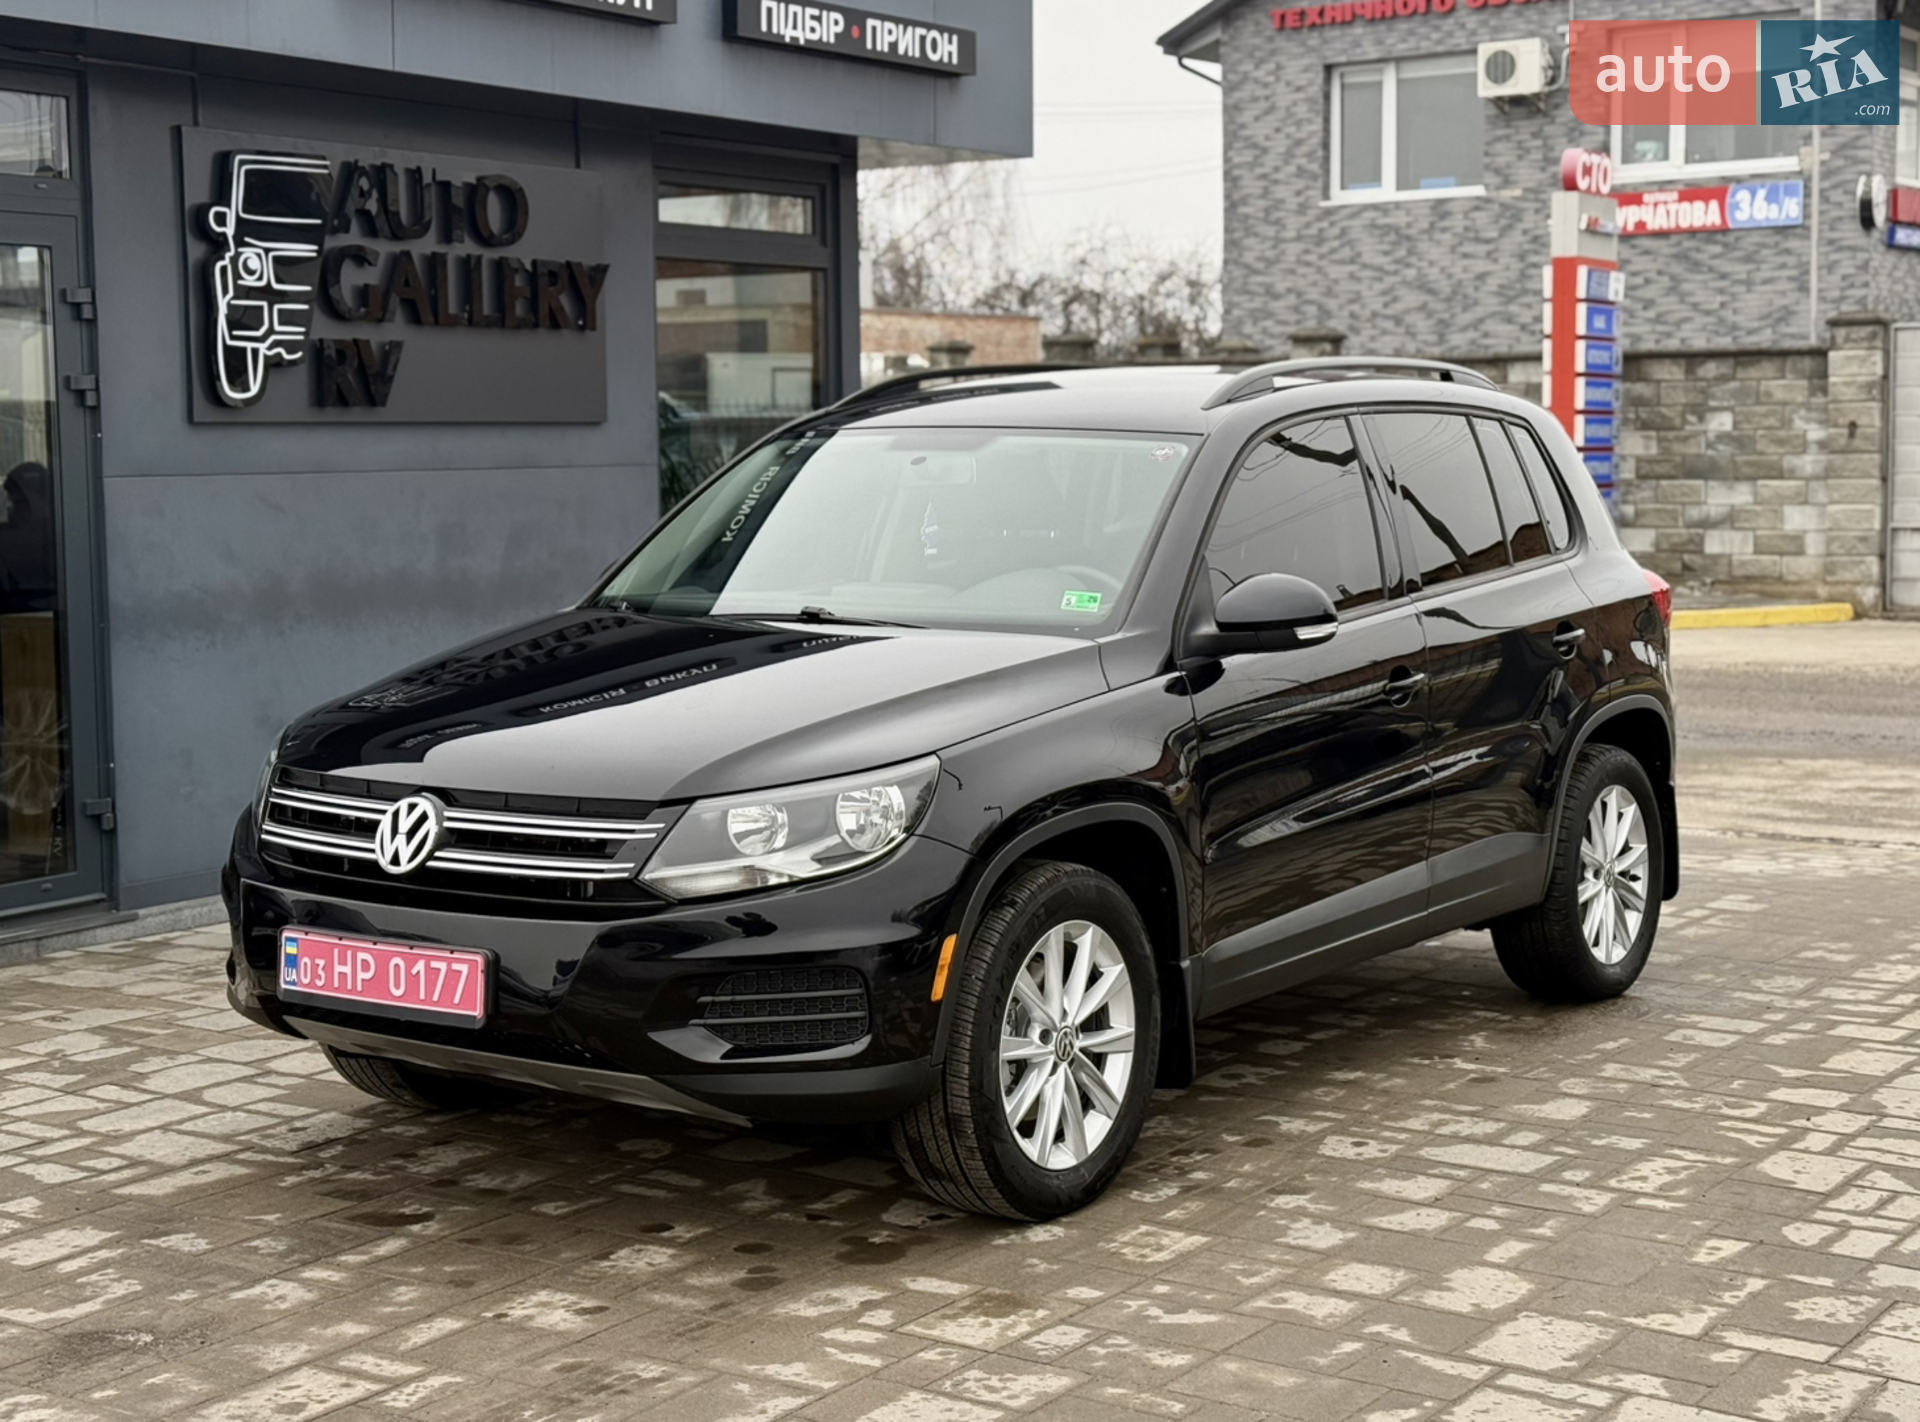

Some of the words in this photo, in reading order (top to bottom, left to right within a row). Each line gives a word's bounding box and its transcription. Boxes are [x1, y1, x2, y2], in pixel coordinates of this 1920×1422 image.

[760, 0, 845, 44] ПІДБІР
[865, 18, 959, 66] ПРИГОН
[1576, 152, 1612, 195] СТО
[328, 158, 530, 247] AUTO
[1615, 199, 1722, 232] УРЧАТОВА
[322, 244, 609, 331] GALLERY
[316, 338, 404, 407] RV
[285, 967, 298, 984] UA
[299, 957, 326, 988] 03
[388, 957, 470, 1005] 0177
